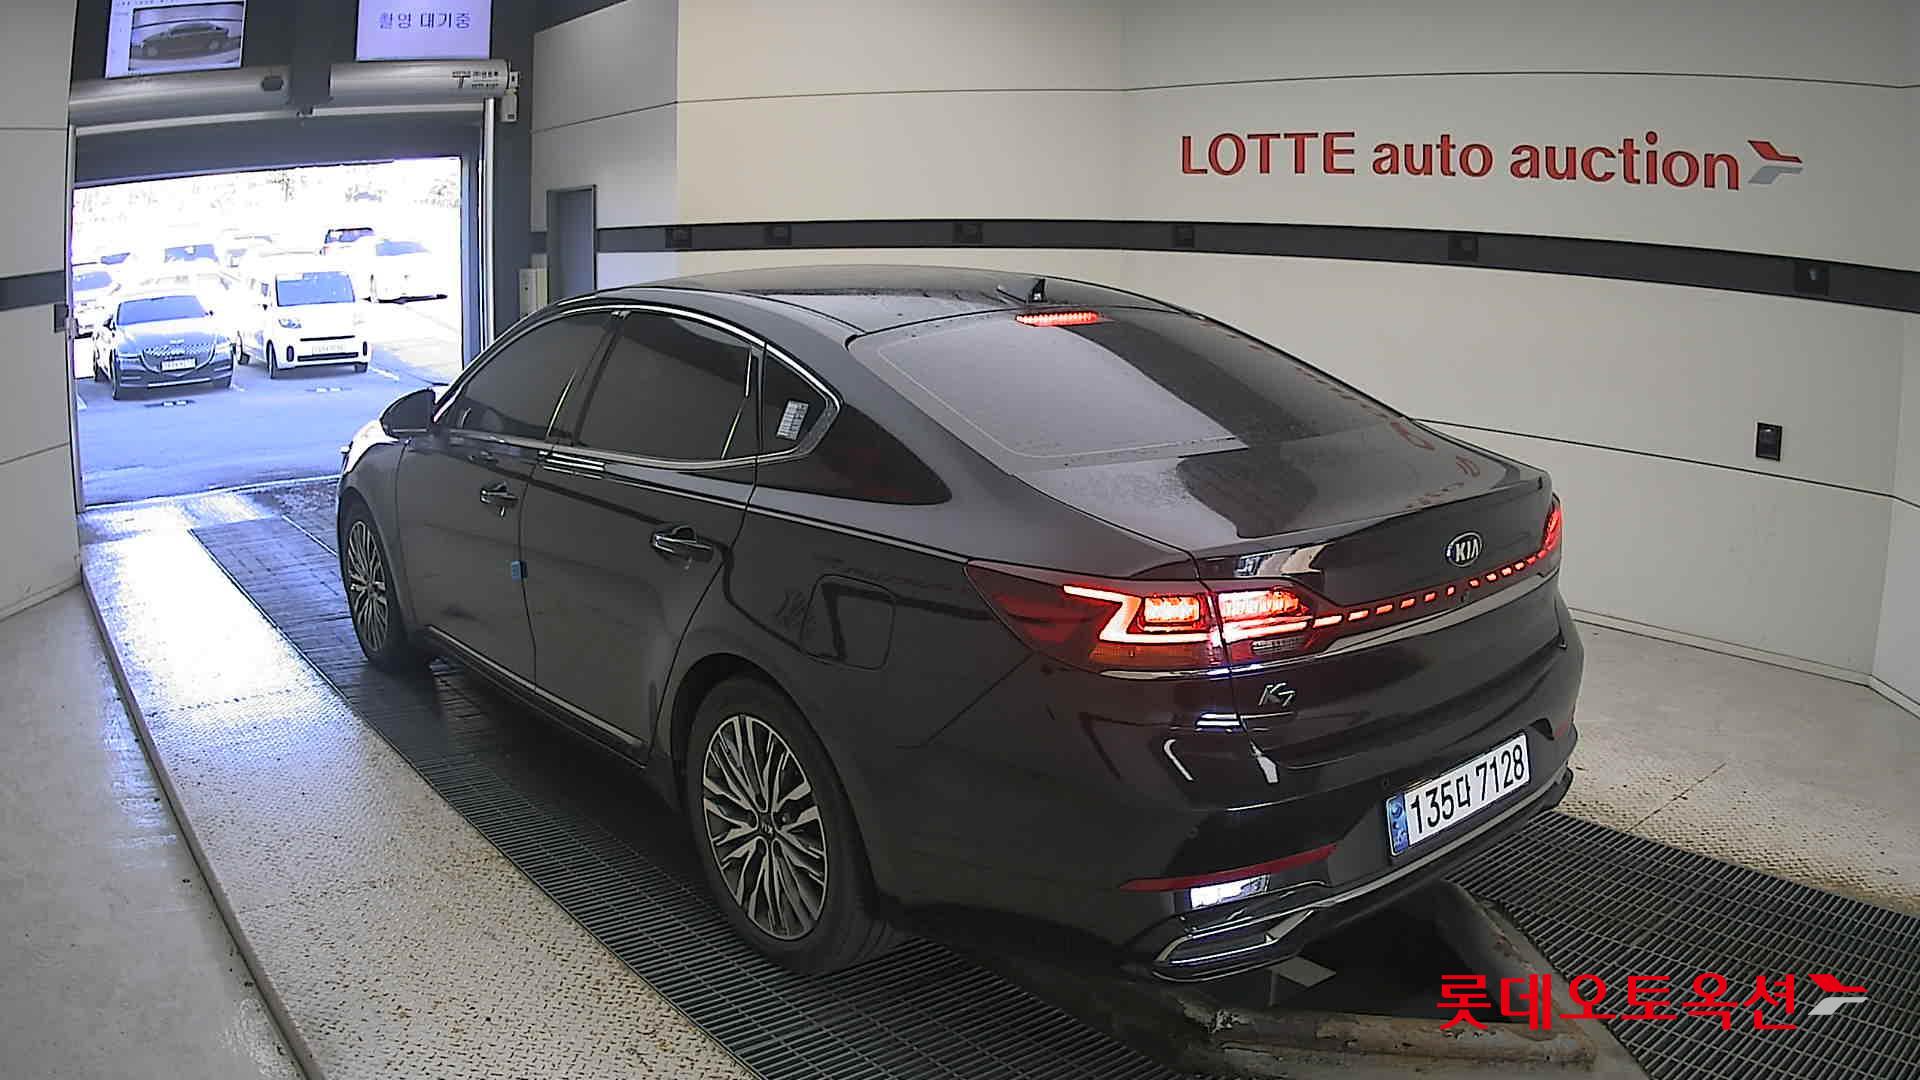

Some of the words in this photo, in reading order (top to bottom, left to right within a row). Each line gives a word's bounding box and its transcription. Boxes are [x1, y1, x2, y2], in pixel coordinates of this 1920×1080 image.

[420, 13, 471, 29] 대기중
[1181, 131, 1356, 176] LOTTE
[1372, 133, 1494, 178] auto
[1510, 131, 1740, 190] auction
[1454, 542, 1480, 561] KIA
[1258, 682, 1296, 707] K7
[1410, 773, 1471, 834] 135다
[1475, 744, 1525, 801] 7128
